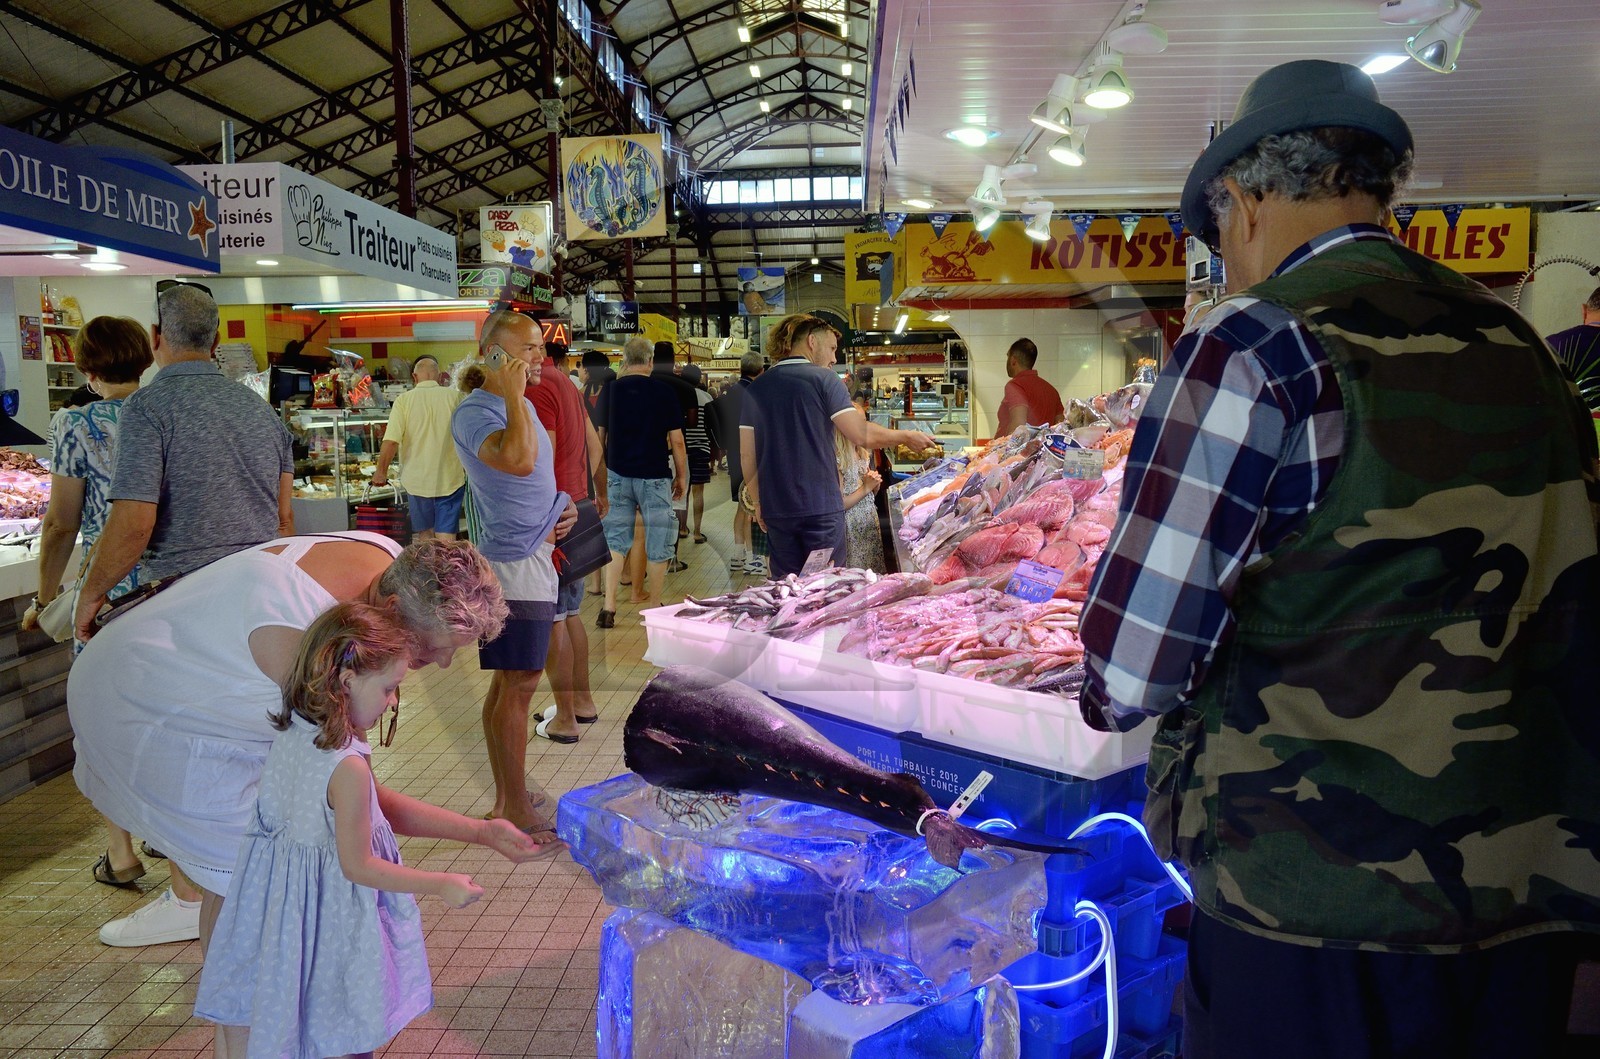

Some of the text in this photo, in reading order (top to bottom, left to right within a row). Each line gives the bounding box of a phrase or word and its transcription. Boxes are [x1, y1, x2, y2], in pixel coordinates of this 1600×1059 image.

[77, 174, 120, 220] DE
[126, 188, 182, 236] MER
[488, 210, 514, 221] DAISY
[495, 221, 520, 232] PIZZA
[344, 209, 417, 273] Traiteur
[417, 235, 453, 262] Plats cuisinés
[421, 261, 452, 283] Charcuterie
[857, 746, 959, 784] PORT LA TURBALLE 2012
